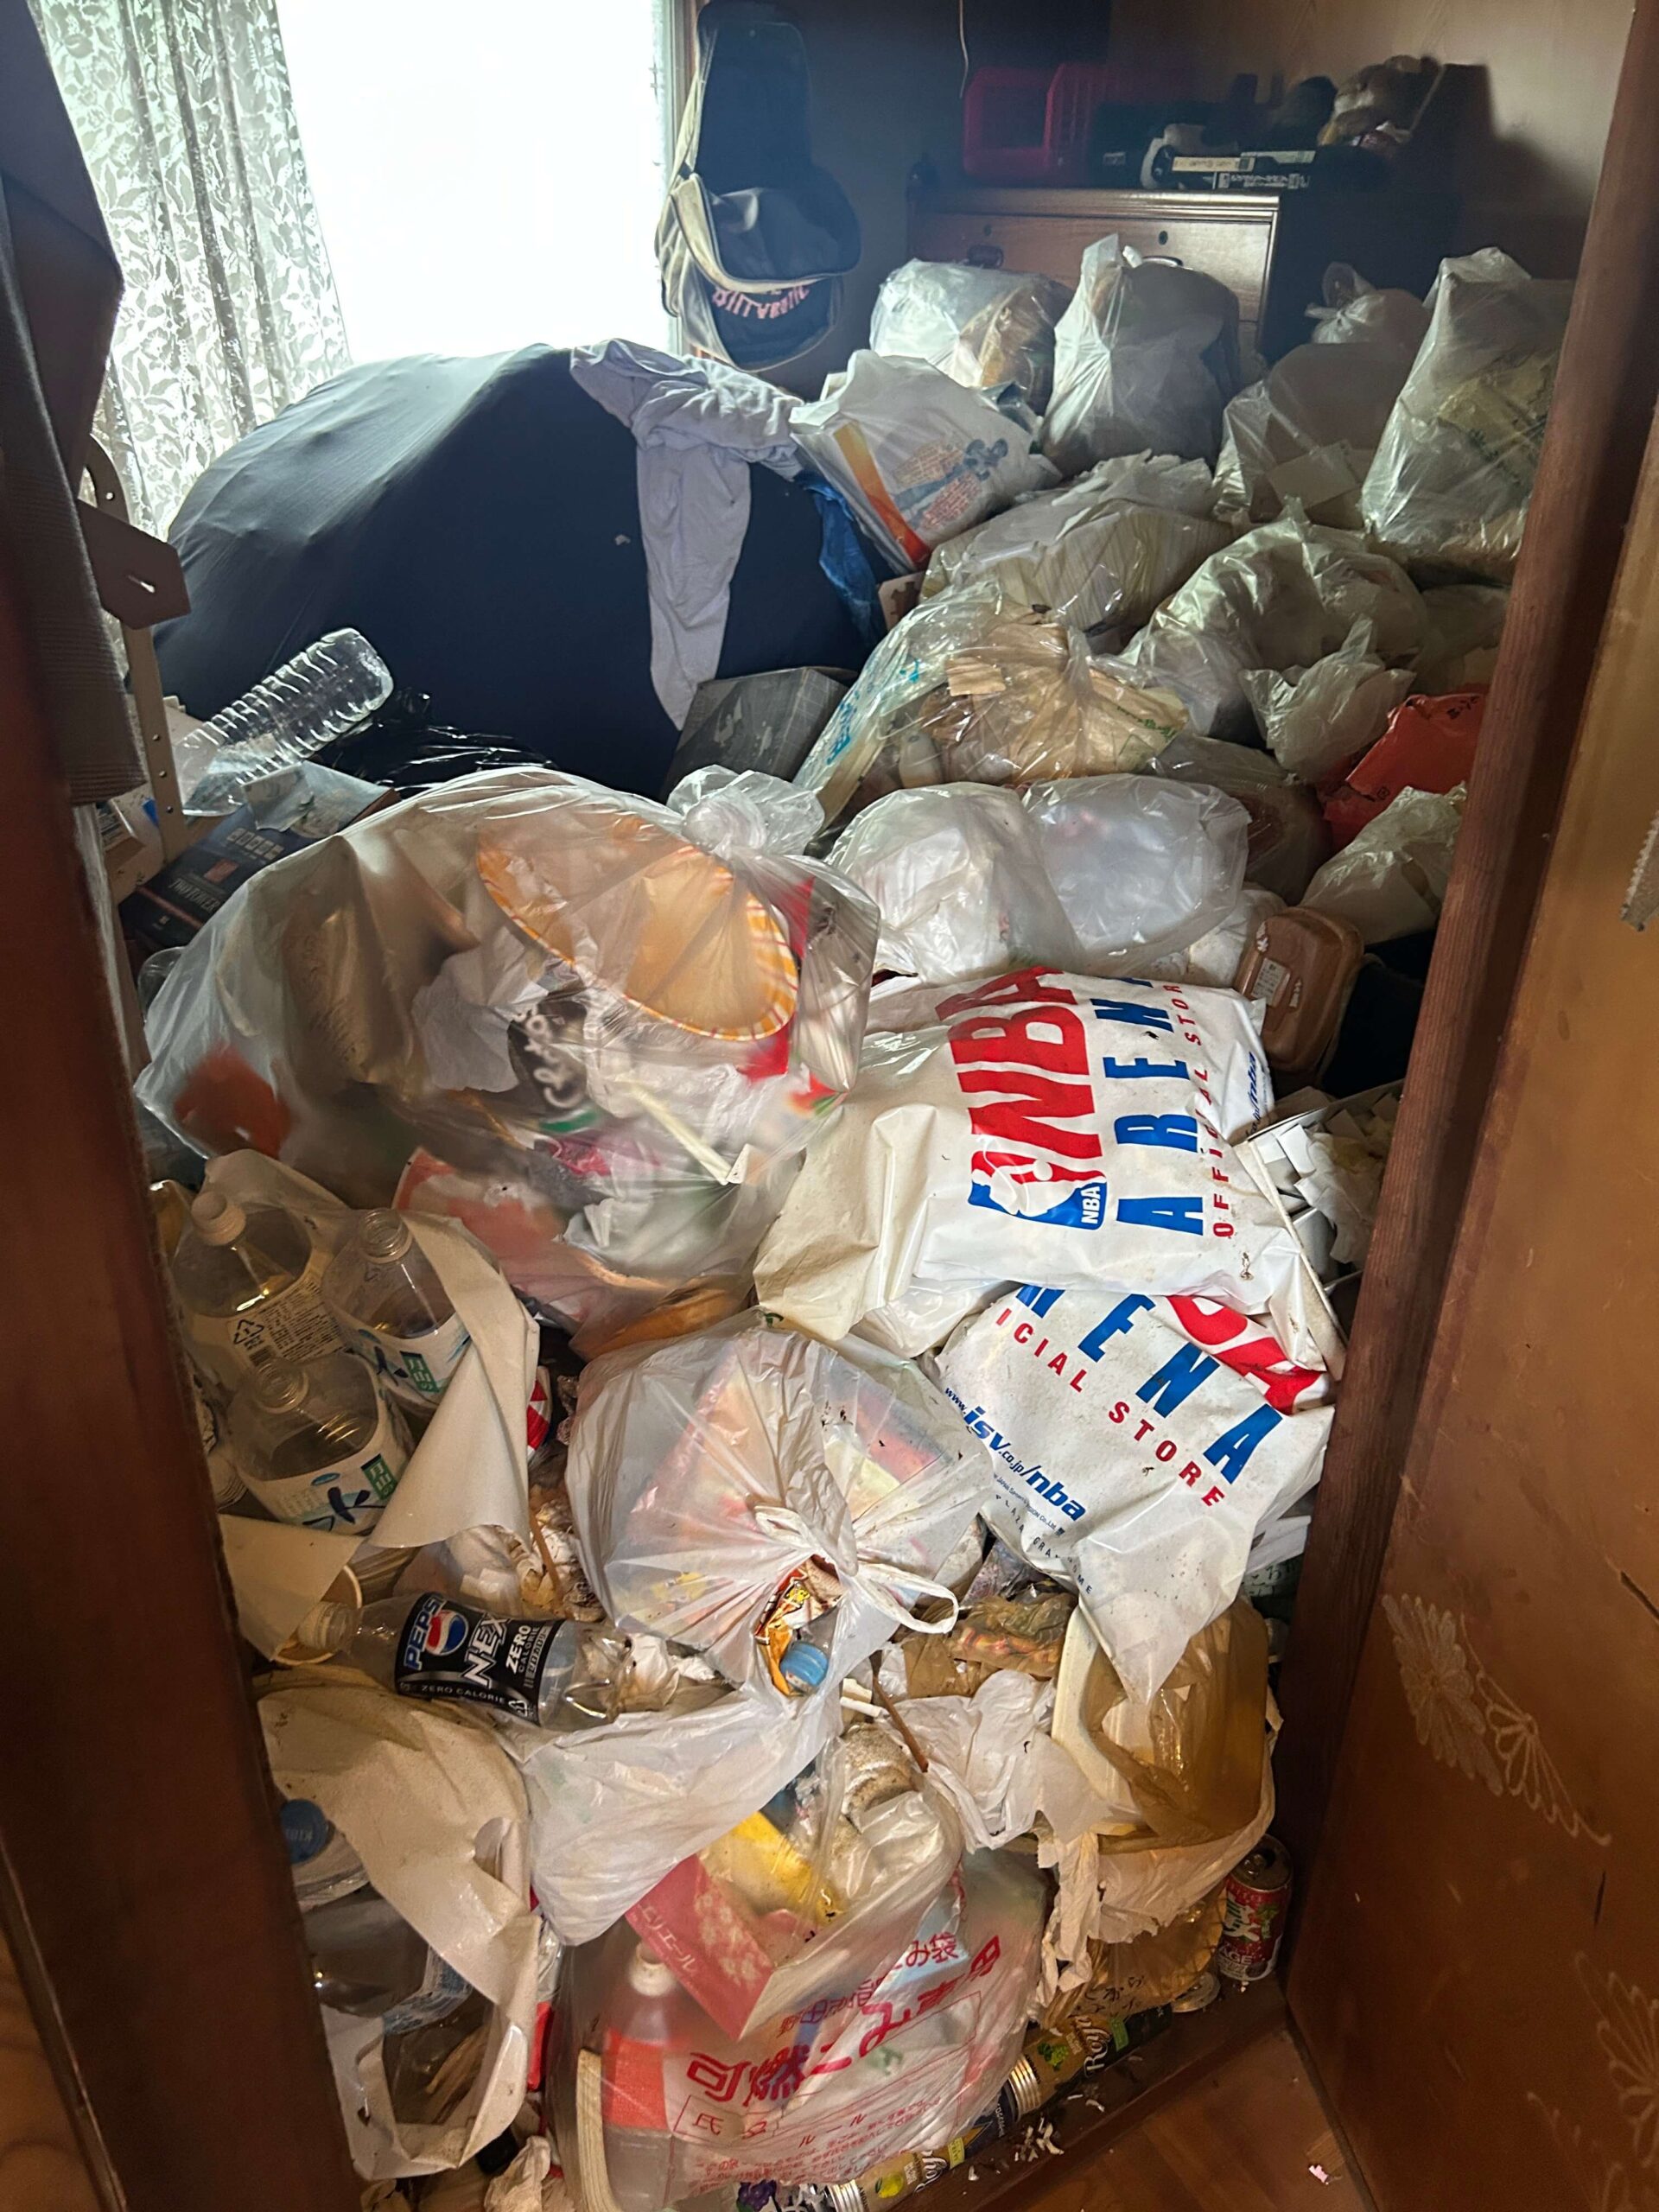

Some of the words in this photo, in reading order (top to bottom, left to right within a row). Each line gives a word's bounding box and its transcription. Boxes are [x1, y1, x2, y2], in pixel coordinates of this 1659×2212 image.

[935, 966, 1103, 1159] NBA
[1090, 977, 1204, 1236] AREN
[1081, 1185, 1102, 1225] NBA
[944, 1387, 1087, 1522] www.isv.co.jp/nba
[1109, 1401, 1225, 1507] STORE
[460, 1611, 512, 1690] NEX
[505, 1624, 532, 1675] ZERO
[518, 1626, 541, 1674] CALORIE
[421, 1685, 454, 1695] ZERO
[454, 1688, 506, 1705] CALORIE
